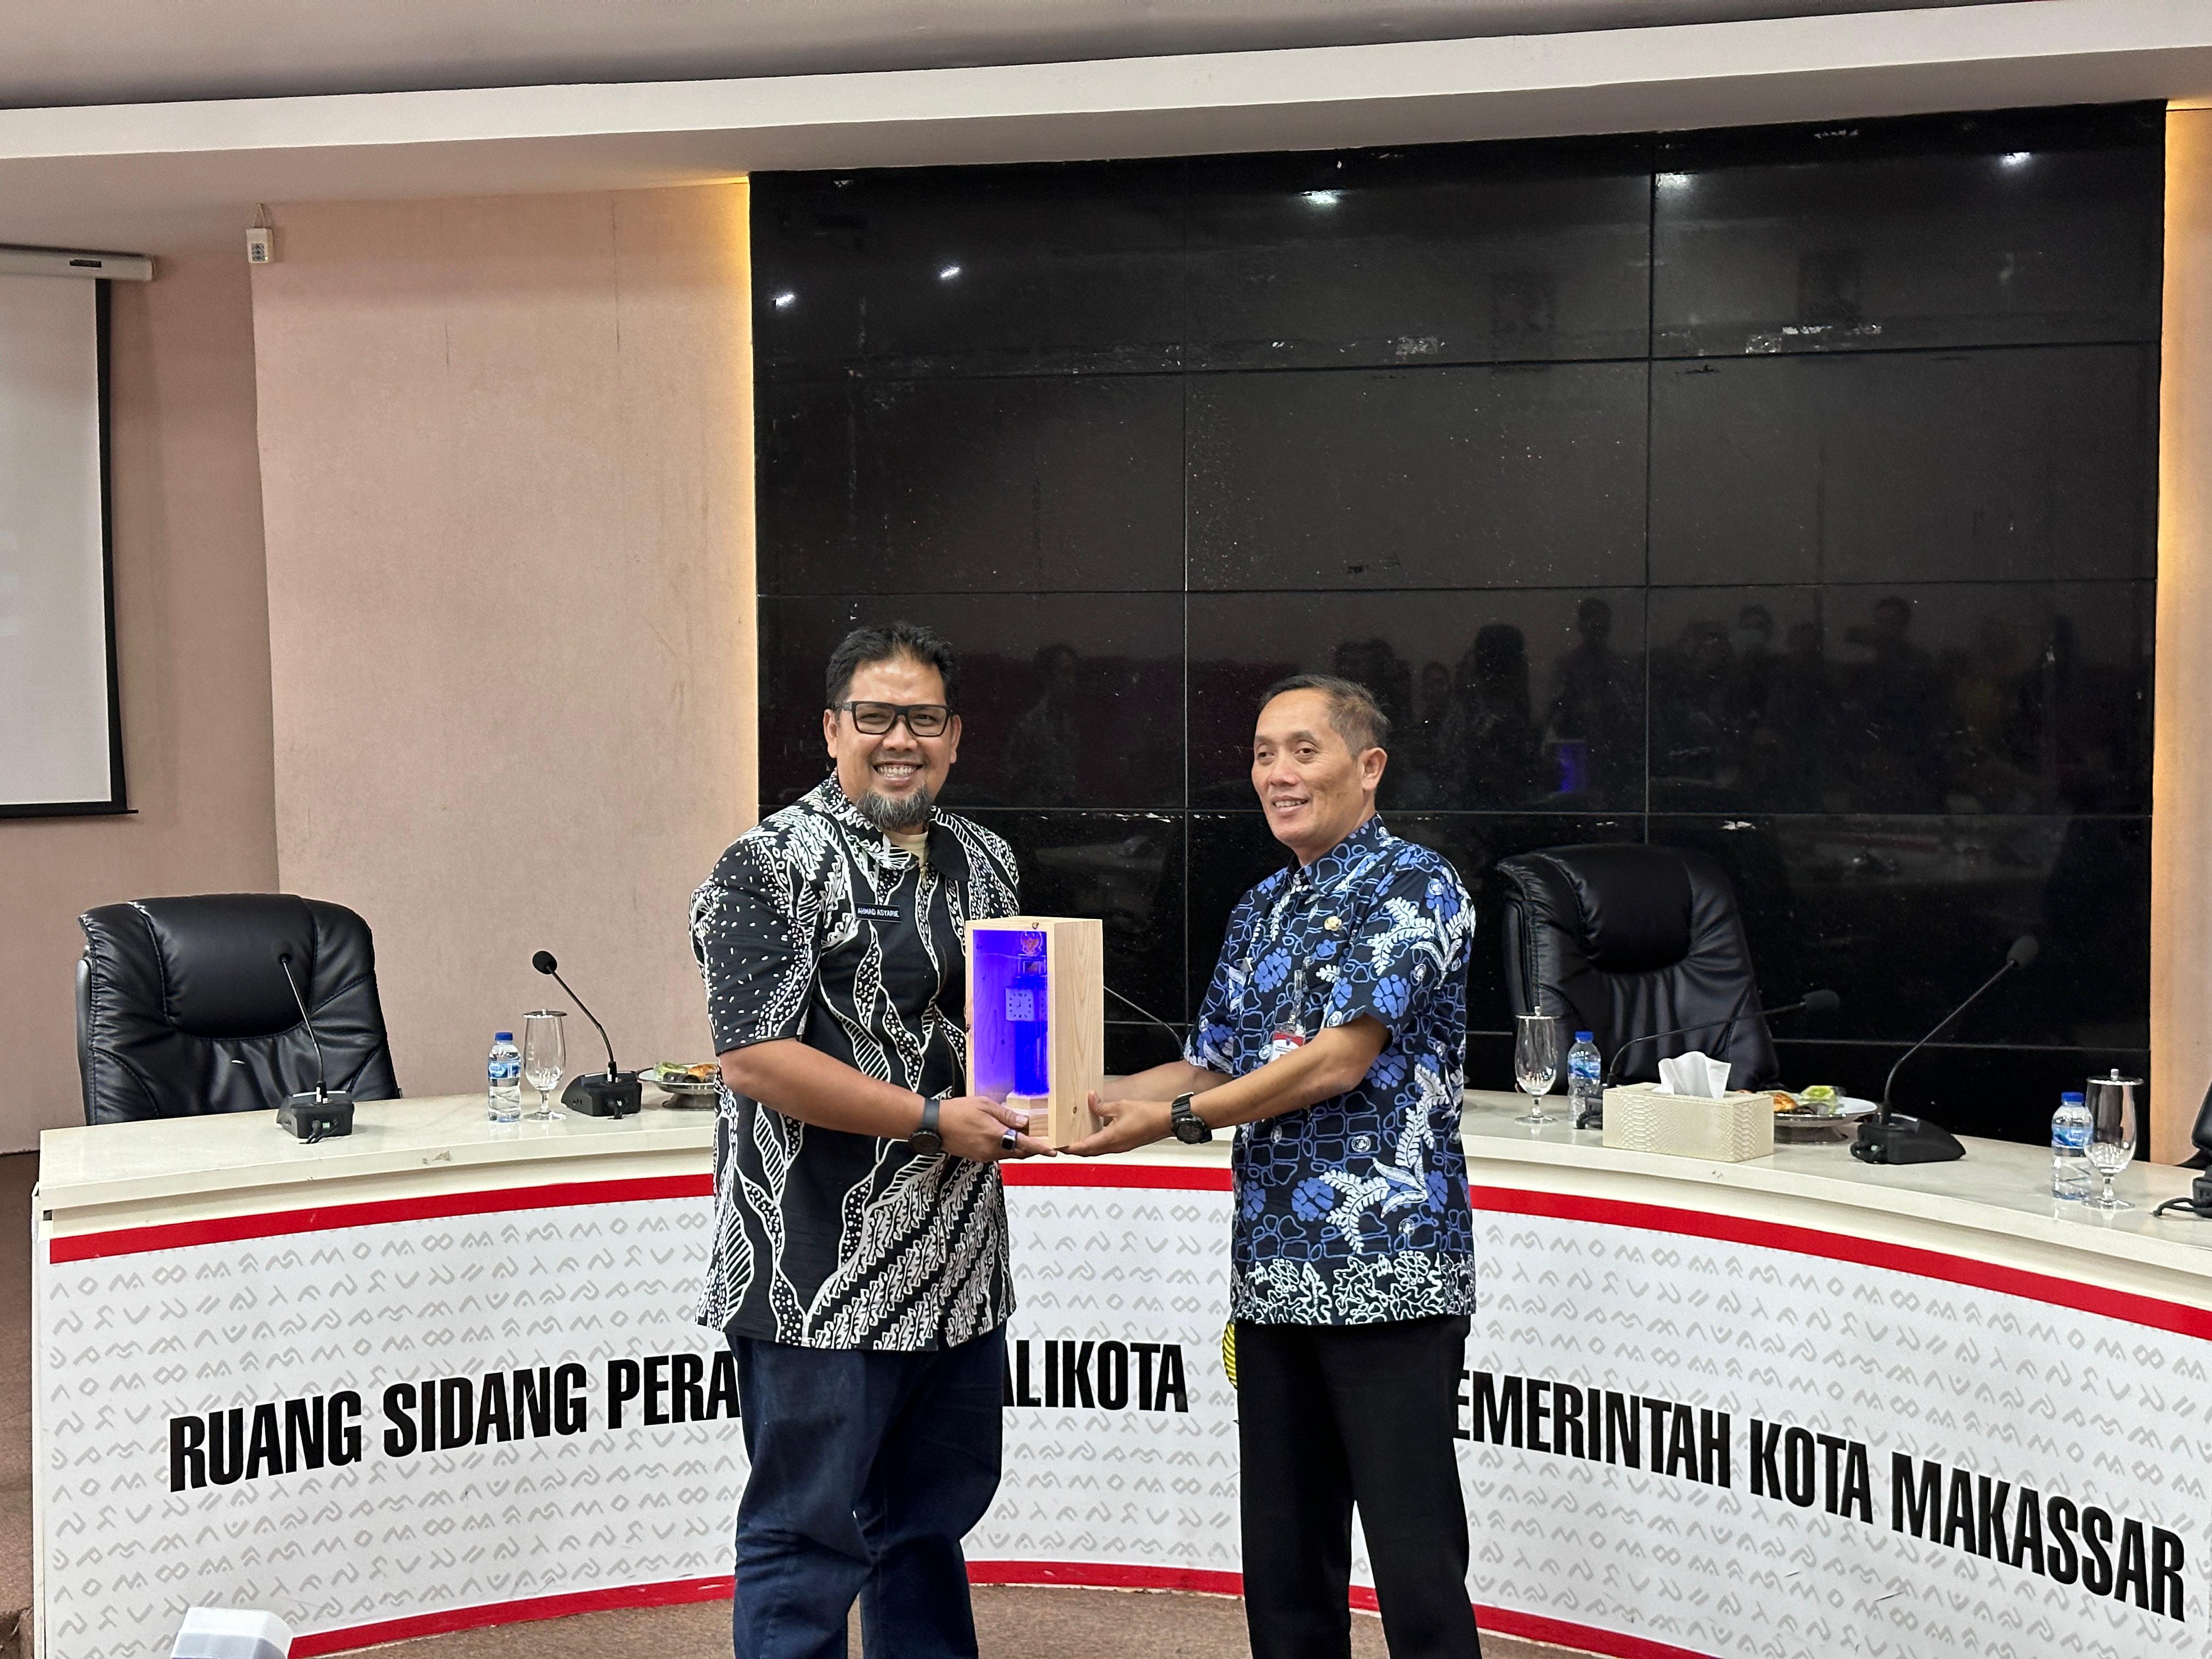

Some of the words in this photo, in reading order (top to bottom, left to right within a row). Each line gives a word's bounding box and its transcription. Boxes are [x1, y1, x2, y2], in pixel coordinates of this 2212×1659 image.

[857, 907, 876, 916] AHMAD
[170, 1390, 362, 1493] RUANG
[383, 1363, 587, 1458] SIDANG
[608, 1350, 741, 1430] PERA
[1750, 1419, 1874, 1525] KOTA
[1892, 1452, 2185, 1622] MAKASSAR
